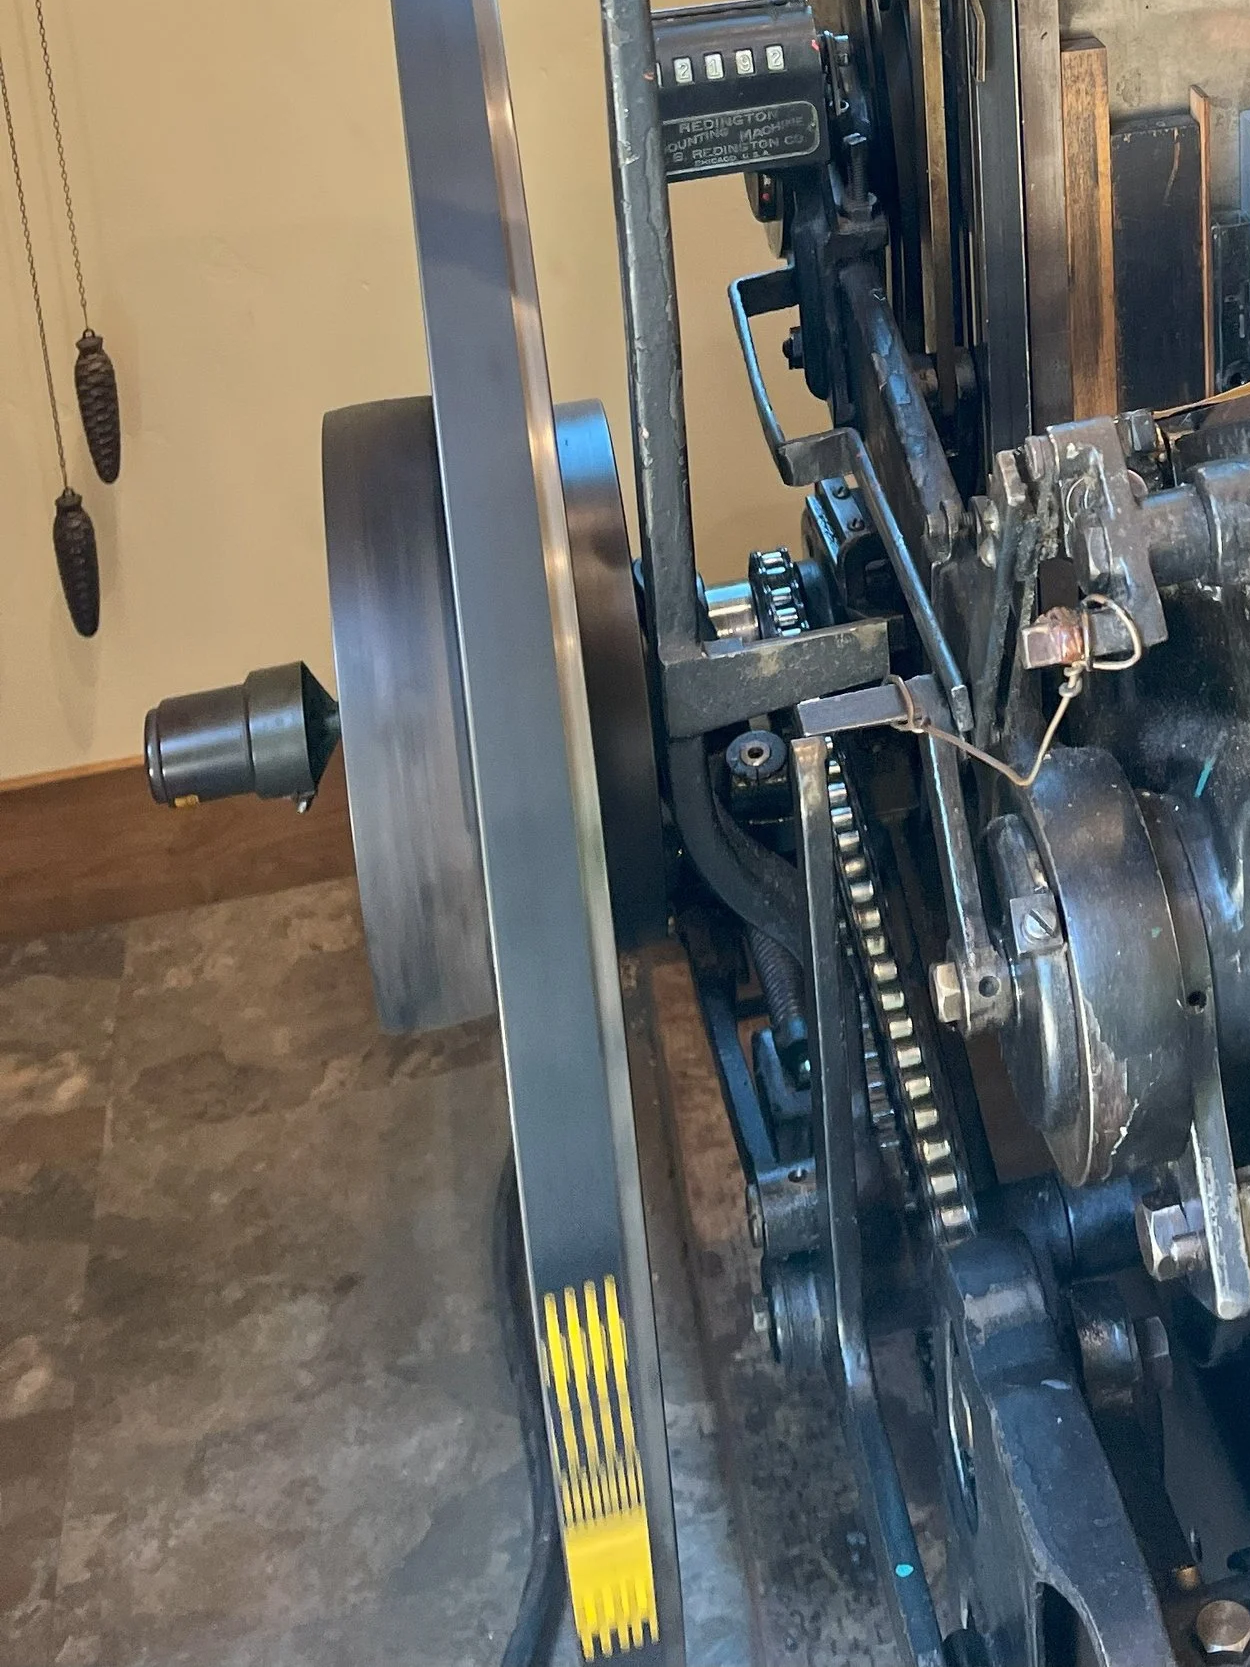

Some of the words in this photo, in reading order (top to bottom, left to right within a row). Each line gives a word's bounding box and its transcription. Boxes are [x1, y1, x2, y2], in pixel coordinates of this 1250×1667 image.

[679, 110, 778, 134] REDINGTON
[740, 116, 804, 145] MACHINE
[692, 137, 780, 160] REDINGTON
